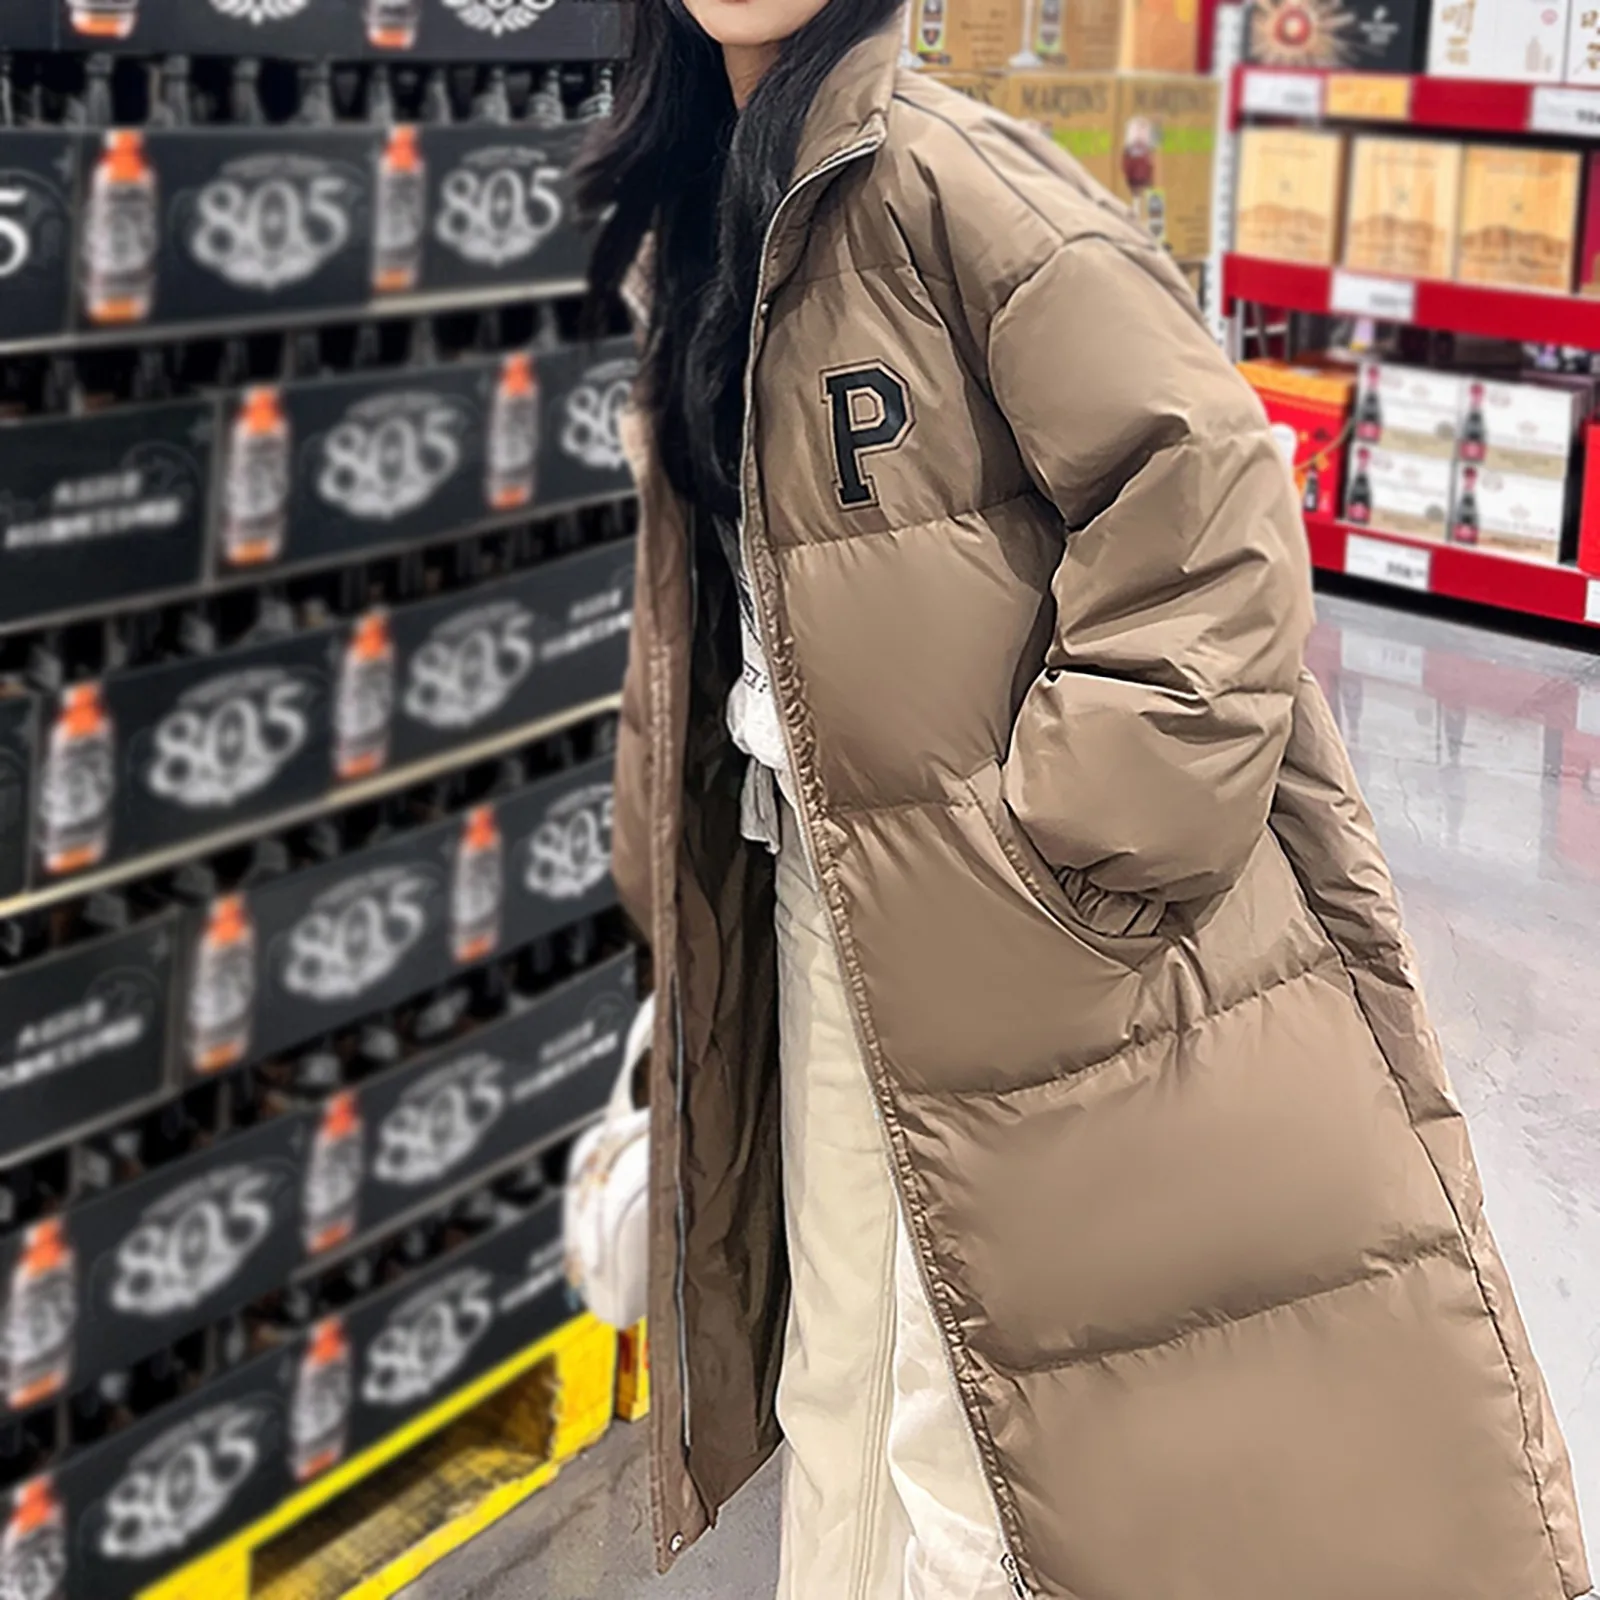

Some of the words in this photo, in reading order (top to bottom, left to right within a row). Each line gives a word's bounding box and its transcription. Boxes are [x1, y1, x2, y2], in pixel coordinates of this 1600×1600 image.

[190, 176, 350, 274] 805
[434, 166, 562, 243] 805
[316, 402, 462, 502] 805
[819, 358, 916, 511] P
[402, 606, 534, 714] 805
[147, 676, 306, 790] 805
[284, 874, 426, 984] 805
[374, 1072, 504, 1168] 805
[112, 1180, 272, 1302] 805
[362, 1288, 494, 1394] 805
[100, 1424, 260, 1548] 805
